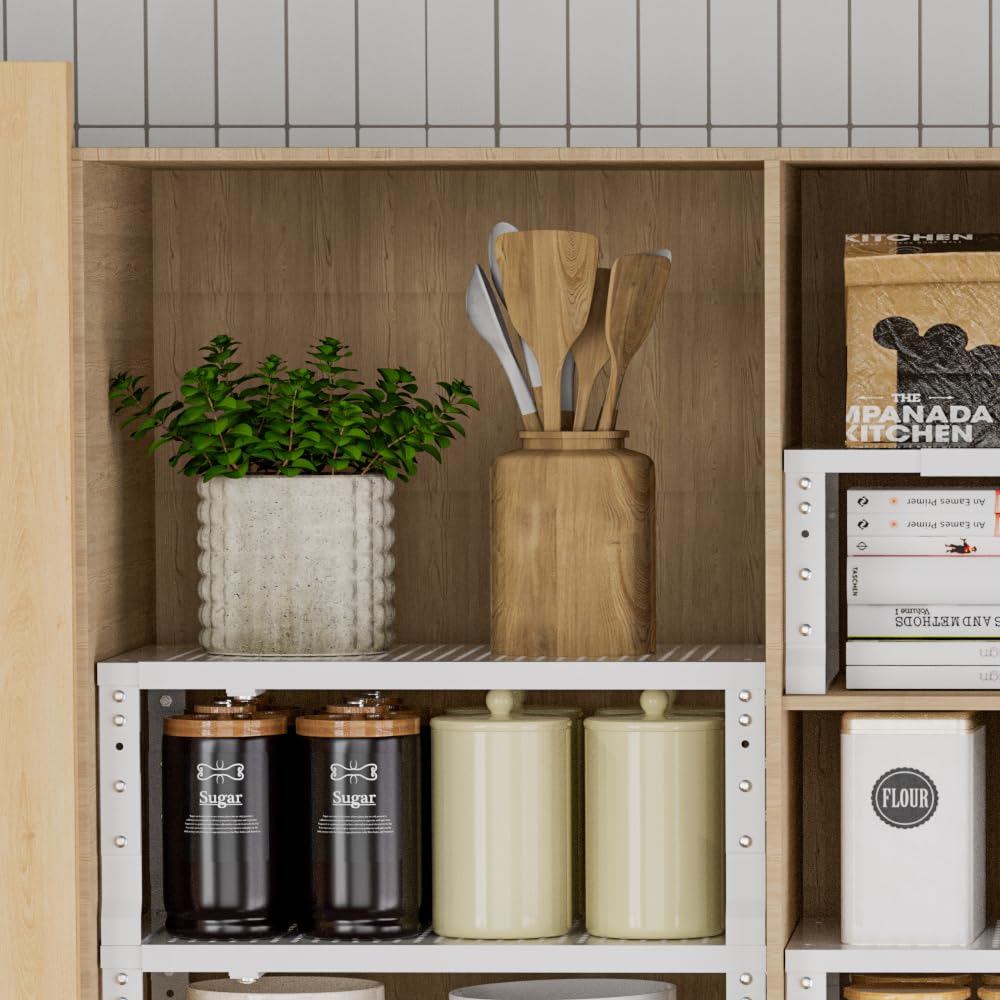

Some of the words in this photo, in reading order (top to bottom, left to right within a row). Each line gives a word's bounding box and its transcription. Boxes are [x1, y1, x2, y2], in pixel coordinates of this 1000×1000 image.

[845, 233, 973, 242] KITCHEN
[891, 393, 921, 403] THE
[907, 498, 937, 506] Primer
[940, 498, 970, 506] Eames
[973, 498, 985, 506] An
[907, 521, 937, 529] Primer
[940, 521, 970, 529] Eames
[973, 521, 985, 529] An
[895, 616, 960, 627] METHODS
[963, 616, 991, 627] AND
[199, 790, 243, 808] Sugar
[332, 790, 376, 808] Sugar
[882, 788, 929, 808] FLOUR
